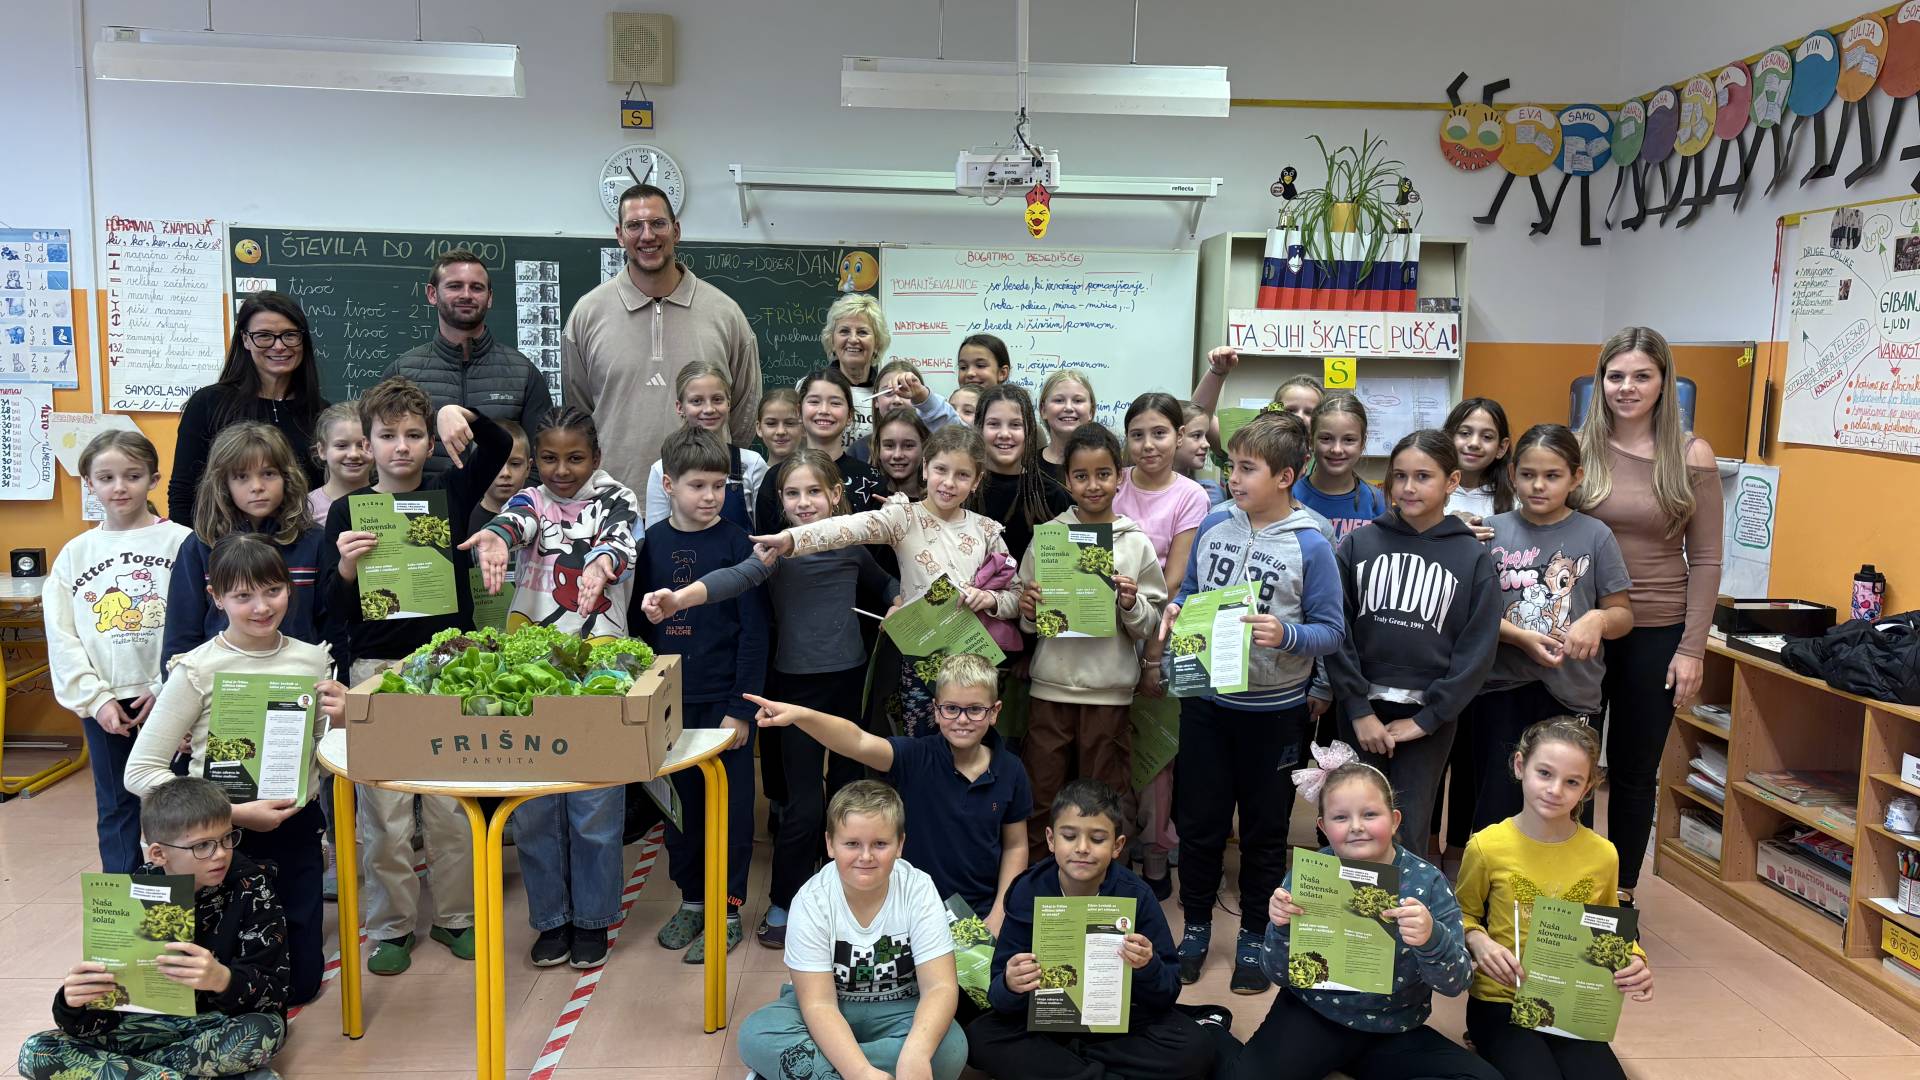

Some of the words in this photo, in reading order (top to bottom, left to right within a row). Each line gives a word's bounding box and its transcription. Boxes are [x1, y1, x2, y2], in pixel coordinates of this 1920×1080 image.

[1806, 40, 1820, 52] VIN
[632, 110, 642, 126] S
[1519, 110, 1542, 120] EVA
[1568, 112, 1595, 122] SAMO
[626, 158, 632, 166] 11
[640, 155, 648, 163] 12
[614, 166, 622, 174] 10
[665, 171, 670, 179] 2
[610, 181, 615, 189] 9
[669, 186, 674, 195] 3
[613, 196, 618, 204] 8
[282, 232, 368, 258] ŠTEVILA
[383, 240, 412, 258] DO
[968, 252, 1014, 262] BOGATIMO
[1027, 252, 1080, 262] BESEDIŠČE
[238, 278, 268, 290] 1000
[1880, 290, 1920, 313] GIBAN
[1884, 317, 1910, 334] LJUDI
[1230, 324, 1258, 348] TA
[1262, 324, 1304, 348] SUHI
[1310, 320, 1382, 349] ŠKAFEC
[1880, 343, 1920, 358] VARNOST
[1328, 361, 1349, 384] S
[125, 384, 199, 396] SAMOGLASNIK
[360, 523, 397, 532] slovenska
[1224, 543, 1241, 554] NOT
[1252, 551, 1274, 565] GIVE
[1272, 561, 1286, 571] UP
[1207, 553, 1235, 586] 19
[1356, 552, 1459, 636] LONDON
[1388, 617, 1409, 628] Great,
[1410, 622, 1425, 630] 1991
[431, 730, 568, 755] FRIŠNO
[1300, 874, 1320, 884] Naša
[1794, 868, 1825, 888] FRACTION
[1300, 882, 1338, 895] slovenska
[1300, 891, 1323, 900] solata
[92, 898, 112, 907] Naša
[92, 907, 130, 916] slovenska
[92, 915, 115, 924] solata
[1539, 921, 1560, 931] Naša
[1538, 929, 1578, 942] slovenska
[1536, 936, 1560, 947] solata
